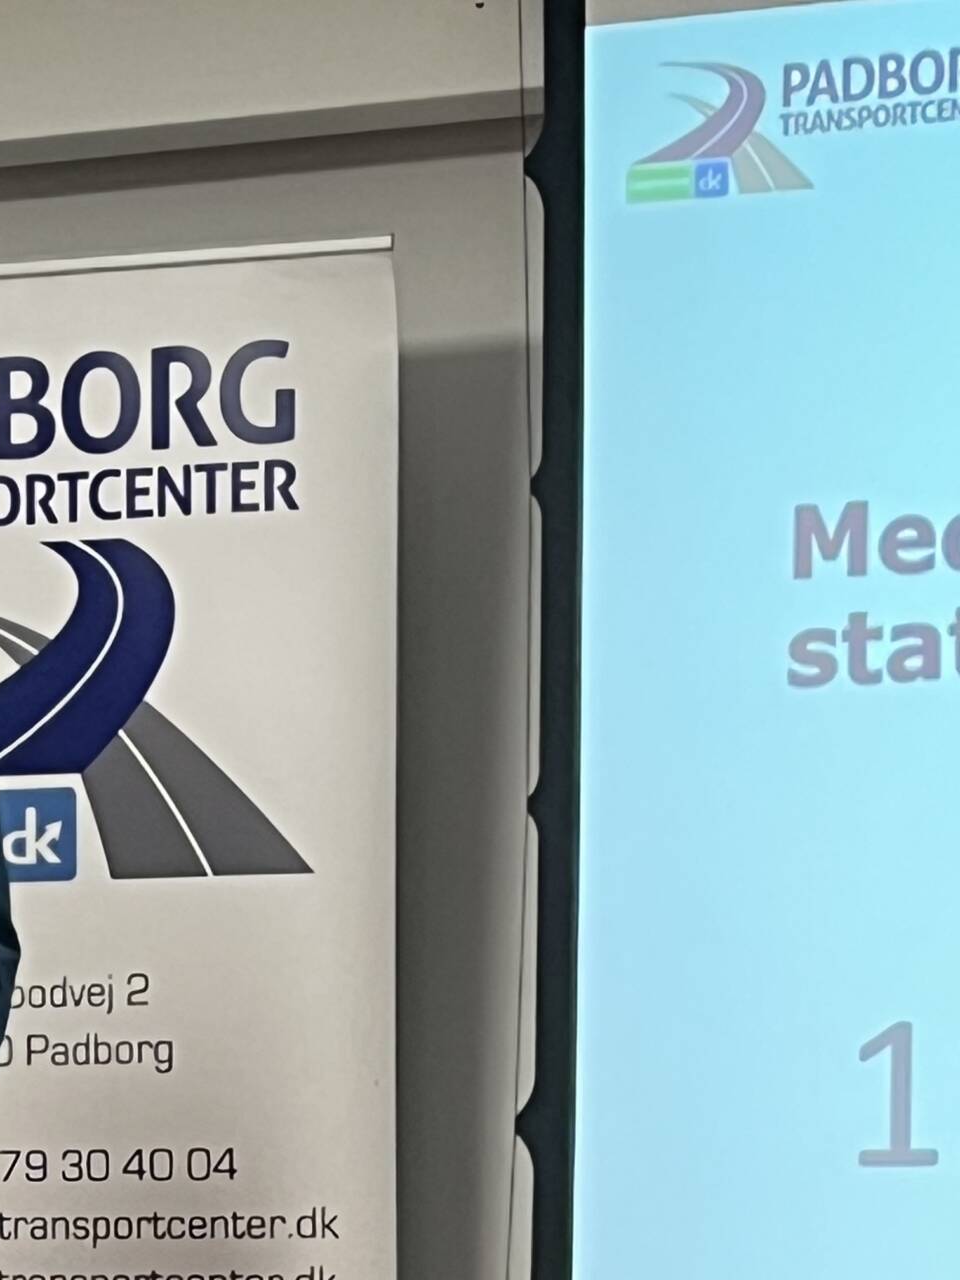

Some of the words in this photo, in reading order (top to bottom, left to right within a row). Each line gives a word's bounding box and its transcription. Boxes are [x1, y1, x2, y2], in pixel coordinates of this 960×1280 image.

[2, 806, 62, 865] dk
[126, 973, 150, 1006] 2
[26, 1032, 175, 1073] Padborg
[858, 1020, 939, 1167] 1
[61, 1149, 111, 1182] 30
[122, 1148, 174, 1182] 40
[186, 1147, 238, 1181] 04
